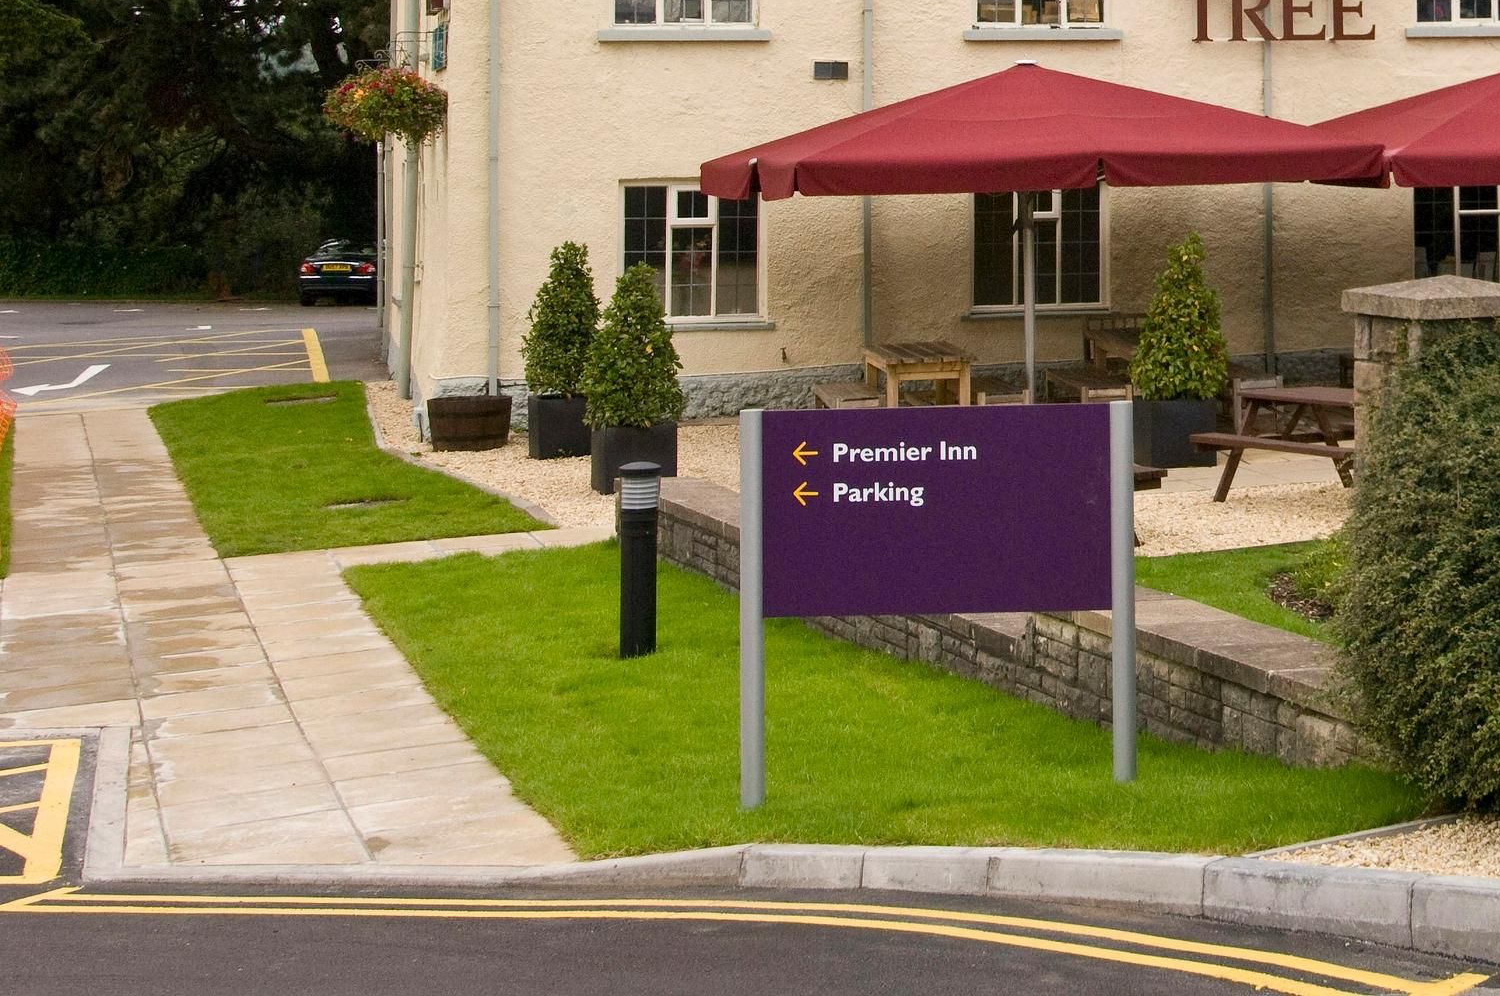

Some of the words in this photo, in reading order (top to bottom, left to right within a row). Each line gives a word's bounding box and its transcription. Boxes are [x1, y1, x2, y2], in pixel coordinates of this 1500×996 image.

[832, 441, 932, 463] Premier
[939, 440, 978, 461] Inn
[832, 481, 925, 507] Parking
